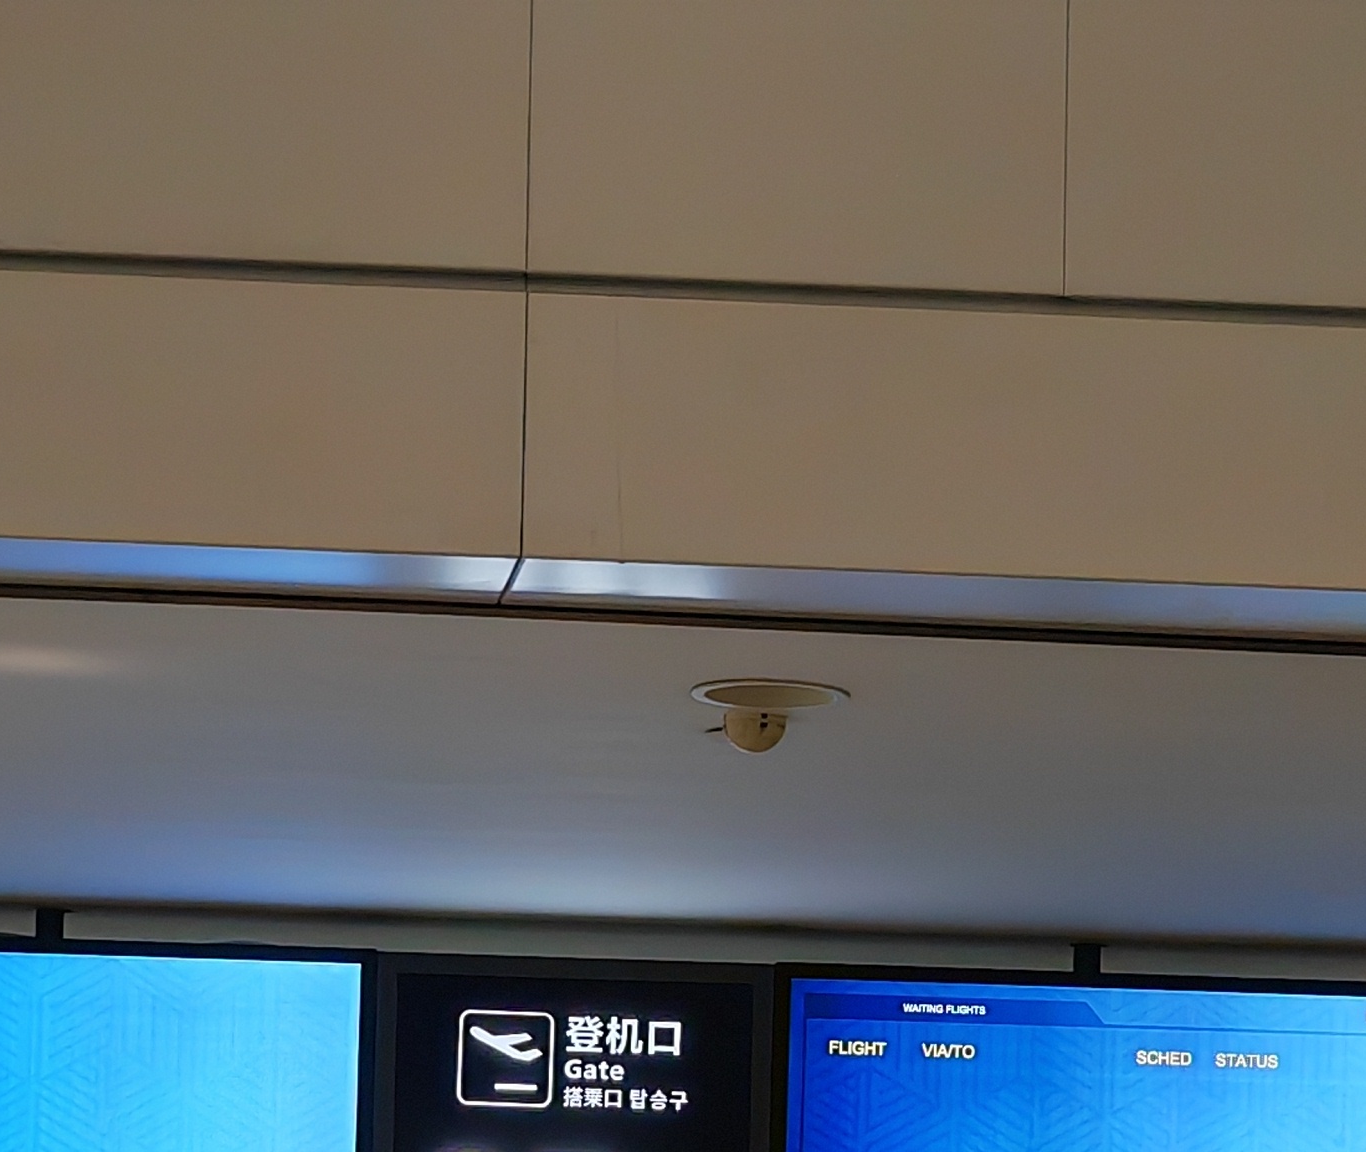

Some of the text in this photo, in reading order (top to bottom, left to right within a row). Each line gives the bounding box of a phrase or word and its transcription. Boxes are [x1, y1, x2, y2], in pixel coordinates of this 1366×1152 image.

[902, 1003, 987, 1015] WAITING FLIGHTS
[564, 1015, 682, 1056] 登机口
[828, 1040, 1279, 1070] FLIGHT VIA/TO SCHED STATUS
[563, 1059, 625, 1082] Gate
[629, 1088, 689, 1112] 탑승구
